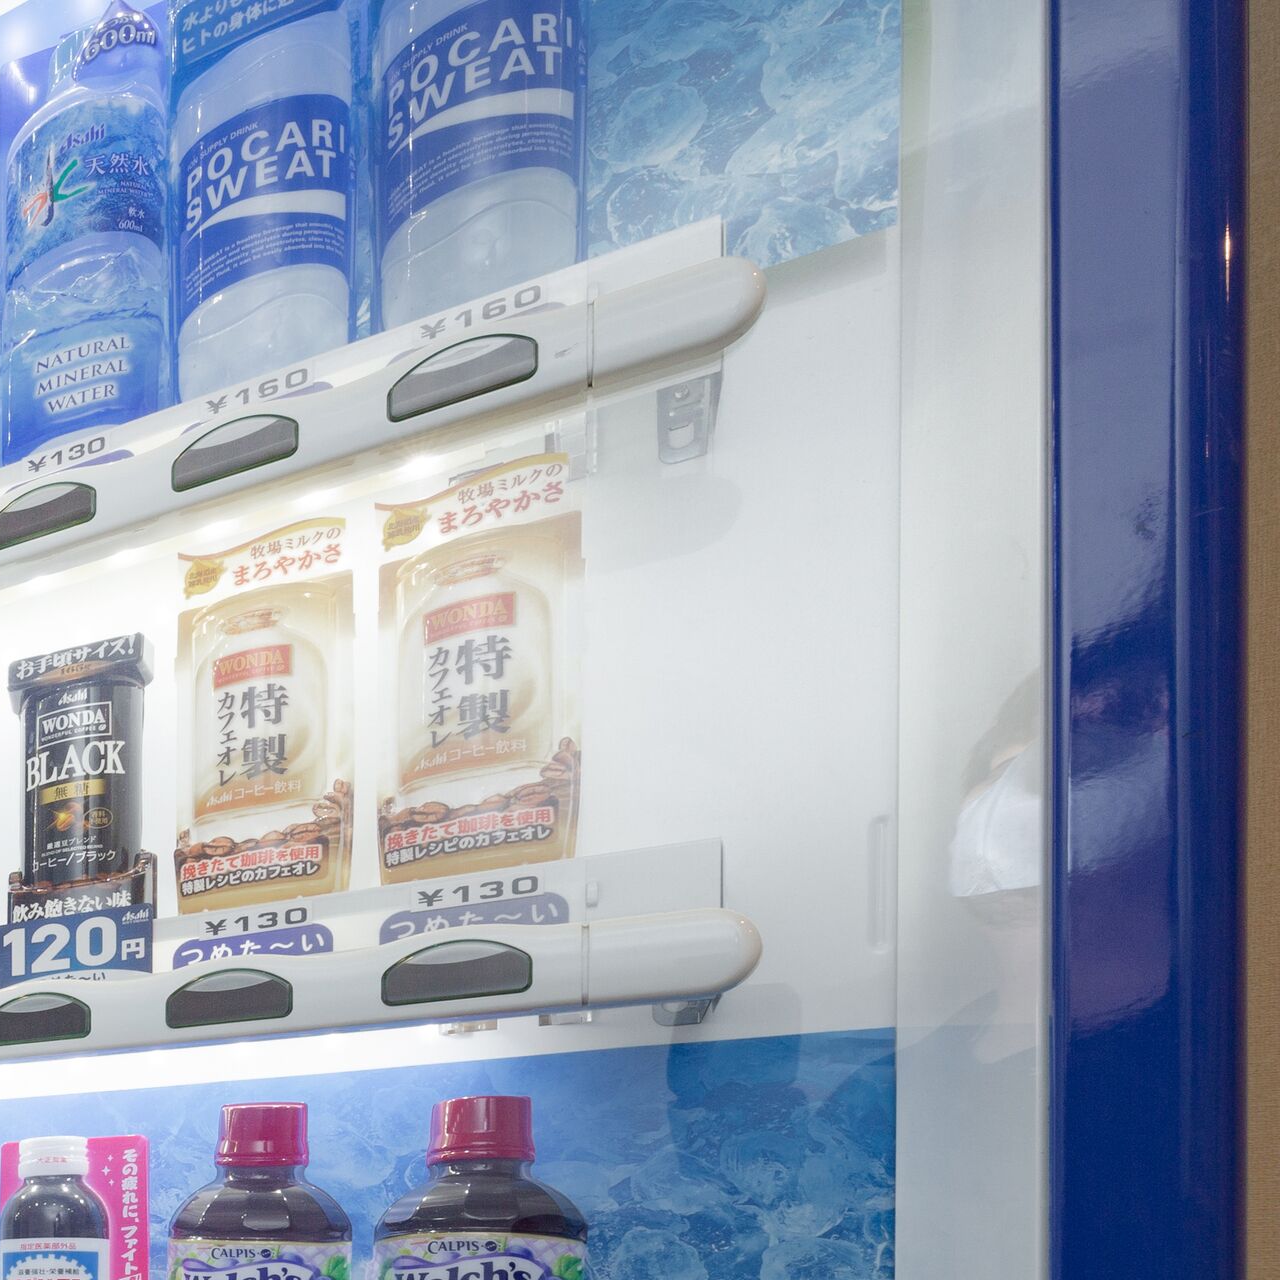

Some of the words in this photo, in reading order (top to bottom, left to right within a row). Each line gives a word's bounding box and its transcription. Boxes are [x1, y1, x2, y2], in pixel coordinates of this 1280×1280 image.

[388, 13, 573, 118] POCARI
[387, 46, 563, 151] SWEAT
[60, 123, 106, 152] Asahi
[85, 153, 151, 177] 天然水
[186, 118, 346, 203] POCARI
[185, 151, 337, 233] SWEAT
[420, 284, 543, 341] ¥160
[37, 334, 131, 373] NATURAL
[38, 358, 129, 396] MINERAL
[206, 367, 309, 415] ¥160
[47, 381, 117, 416] WATER
[27, 435, 107, 474] ¥130
[458, 461, 564, 503] 牧場ミルクの
[438, 480, 565, 535] まろやかさ
[250, 526, 342, 560] 牧場ミルクの
[16, 634, 136, 680] お手頃サイズ!
[58, 688, 87, 705] Asahi
[428, 646, 451, 749] カフェオレ
[455, 634, 512, 739] 特製
[41, 711, 107, 737] WONDA
[216, 690, 237, 788] カフェオレ
[241, 682, 289, 781] 特製
[26, 740, 126, 792] BLACK
[384, 826, 553, 867] 特製レシピのカフェオレ
[385, 806, 554, 848] 挽きたて珈琲を使用
[32, 850, 117, 873] コーヒー/ブラック
[180, 861, 319, 896] 特製レシピのカフェオレ
[181, 844, 321, 880] 挽きたて珈琲を使用
[12, 891, 133, 924] 飲み飽きない味
[416, 875, 539, 907] ¥130
[205, 907, 308, 935] ¥130
[210, 1245, 255, 1261] CALPIS
[427, 1239, 479, 1255] CALPIS
